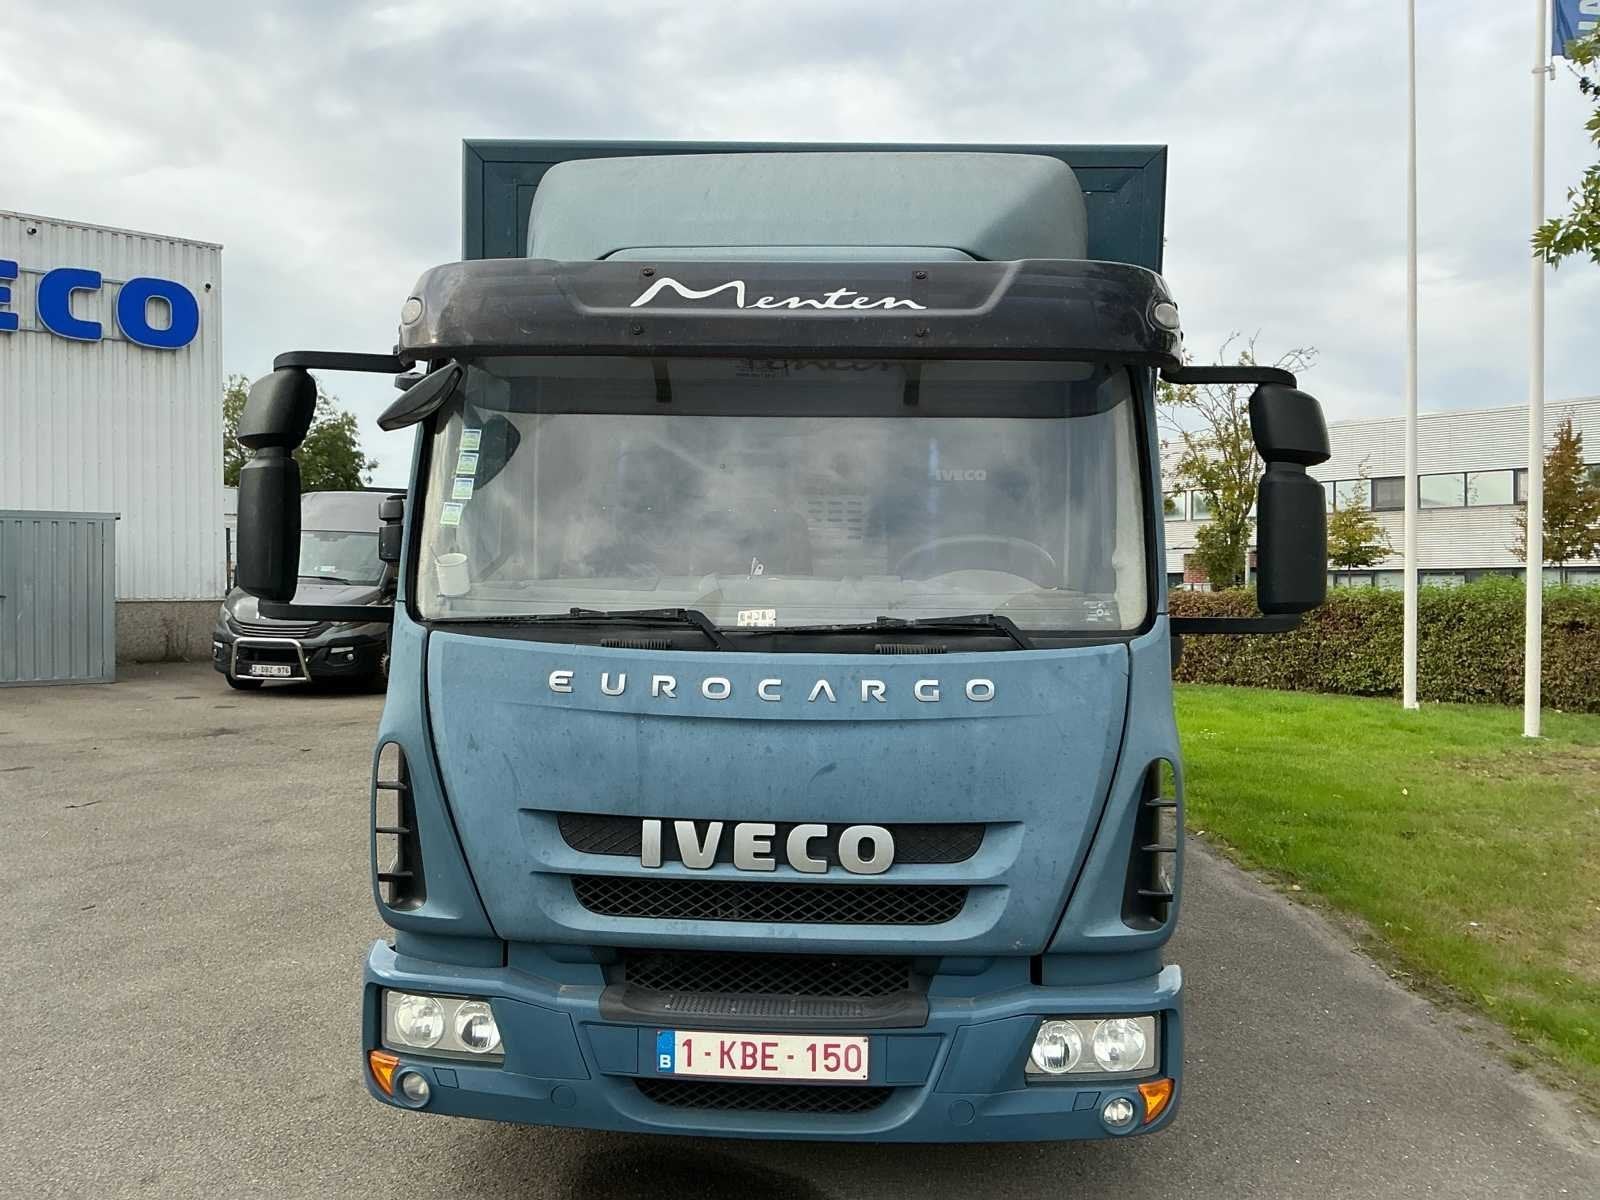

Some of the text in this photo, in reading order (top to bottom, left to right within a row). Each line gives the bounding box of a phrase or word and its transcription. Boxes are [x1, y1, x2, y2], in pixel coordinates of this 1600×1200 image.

[630, 277, 928, 310] Menten
[548, 670, 996, 702] EUROCARGO
[641, 819, 896, 875] IVECO
[659, 1054, 672, 1069] B
